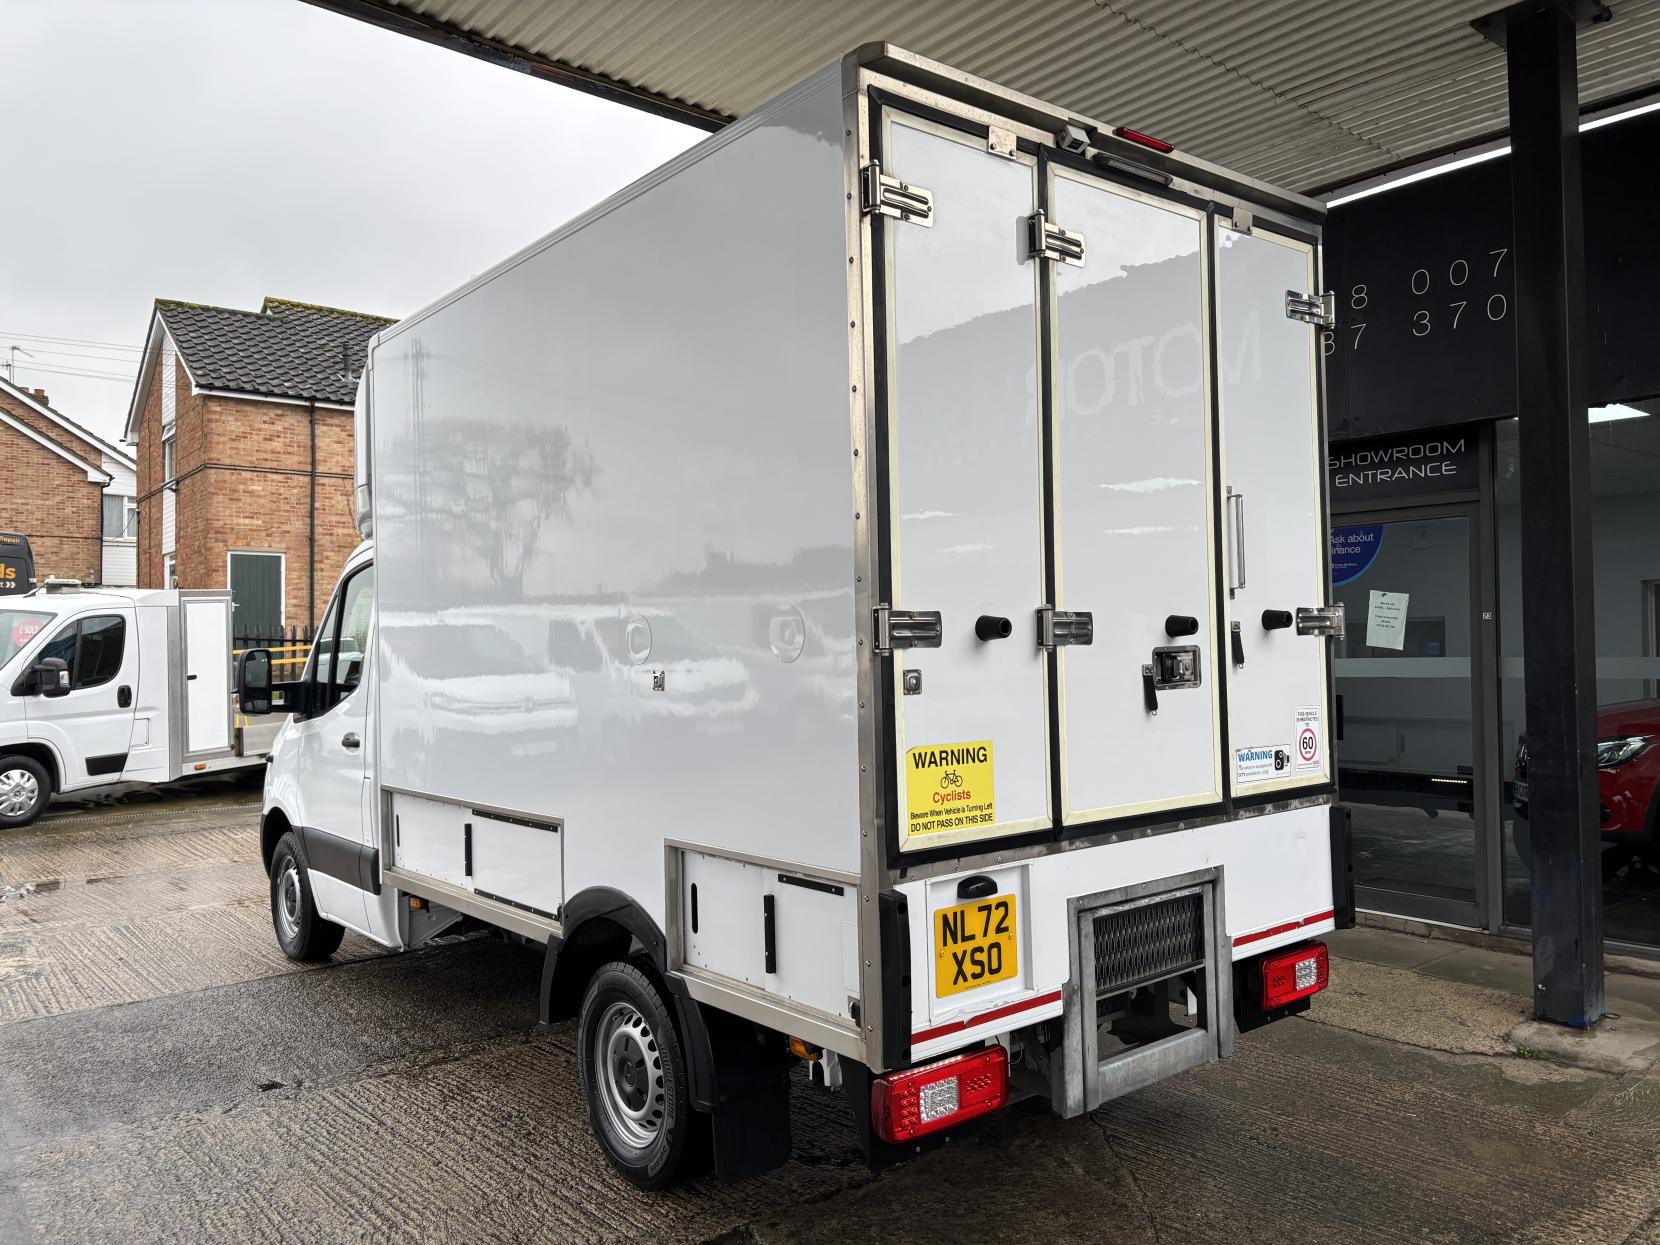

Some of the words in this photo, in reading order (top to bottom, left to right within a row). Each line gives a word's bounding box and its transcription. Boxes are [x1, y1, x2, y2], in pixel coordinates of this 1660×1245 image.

[1328, 439, 1465, 469] SHOWROOM
[1335, 461, 1457, 487] ENTRANCE
[1331, 534, 1345, 544] Ask
[1347, 532, 1374, 543] about
[1331, 546, 1361, 555] inance
[1302, 736, 1314, 750] 60
[913, 747, 987, 769] WARNING
[1238, 751, 1272, 762] WARNING
[933, 790, 971, 805] Cyclists
[910, 809, 929, 820] Beware
[929, 808, 943, 817] When
[944, 807, 960, 815] Vehicle
[966, 803, 983, 813] Turning
[984, 802, 993, 810] Left
[911, 822, 921, 833] DO
[922, 821, 936, 831] NOT
[936, 818, 953, 829] PASS
[954, 817, 964, 827] ON
[965, 815, 979, 825] THIS
[979, 813, 993, 822] SIDE
[952, 942, 1002, 986] XSO
